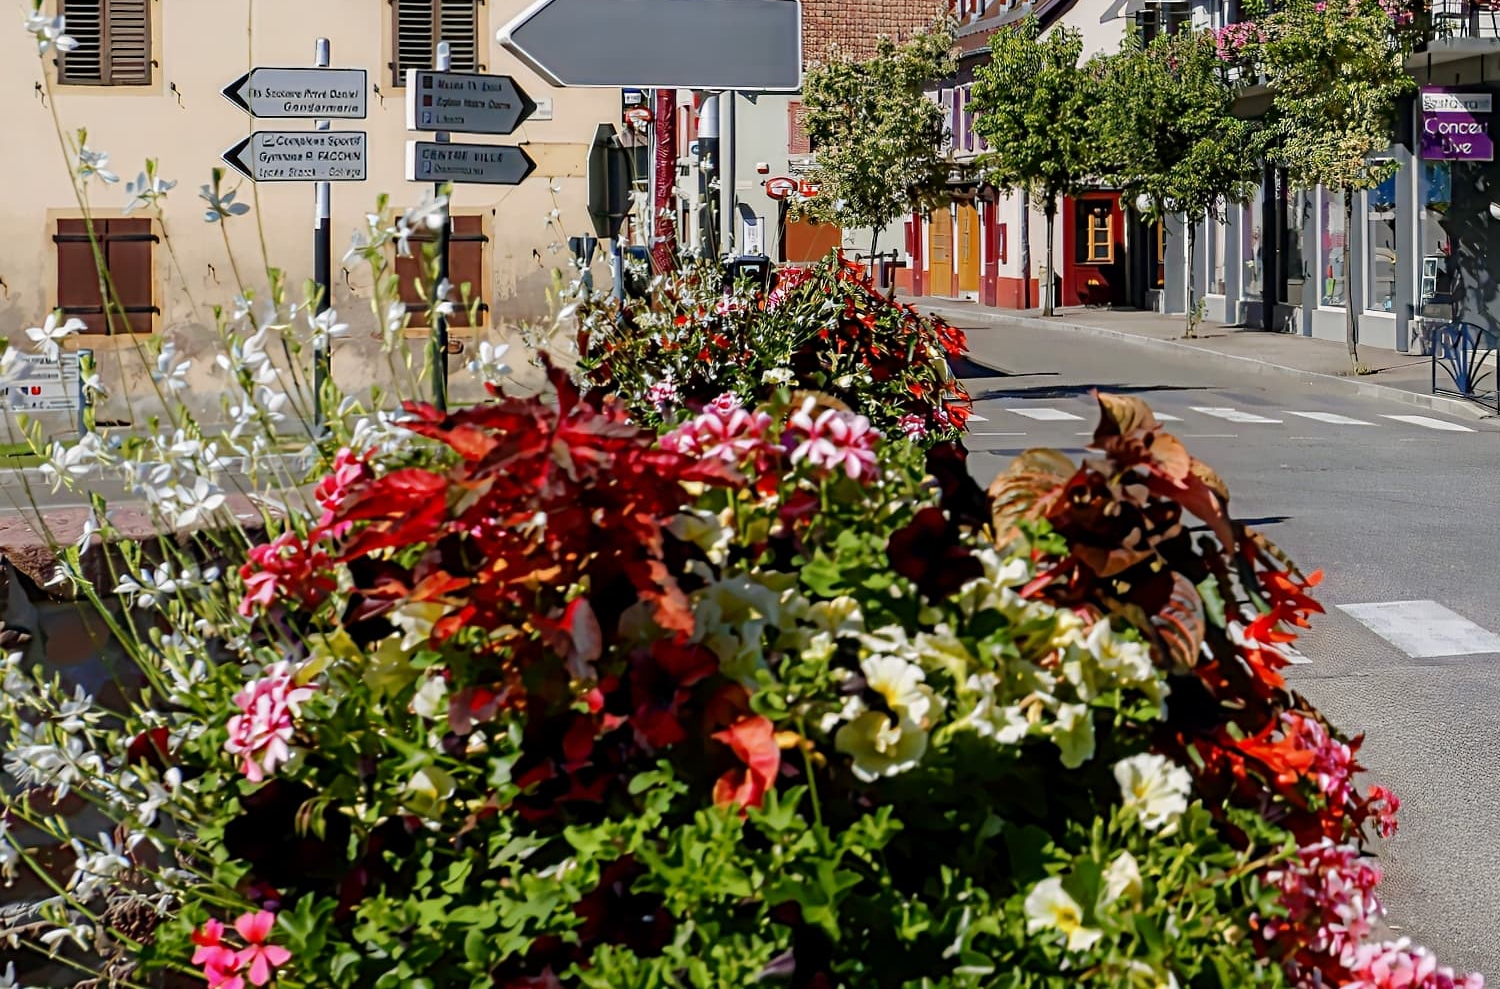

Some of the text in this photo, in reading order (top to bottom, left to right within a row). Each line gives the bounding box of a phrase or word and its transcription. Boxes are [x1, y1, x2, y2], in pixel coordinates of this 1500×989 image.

[283, 101, 359, 113] Gendarmerie
[422, 149, 505, 163] CENTRE VILLE
